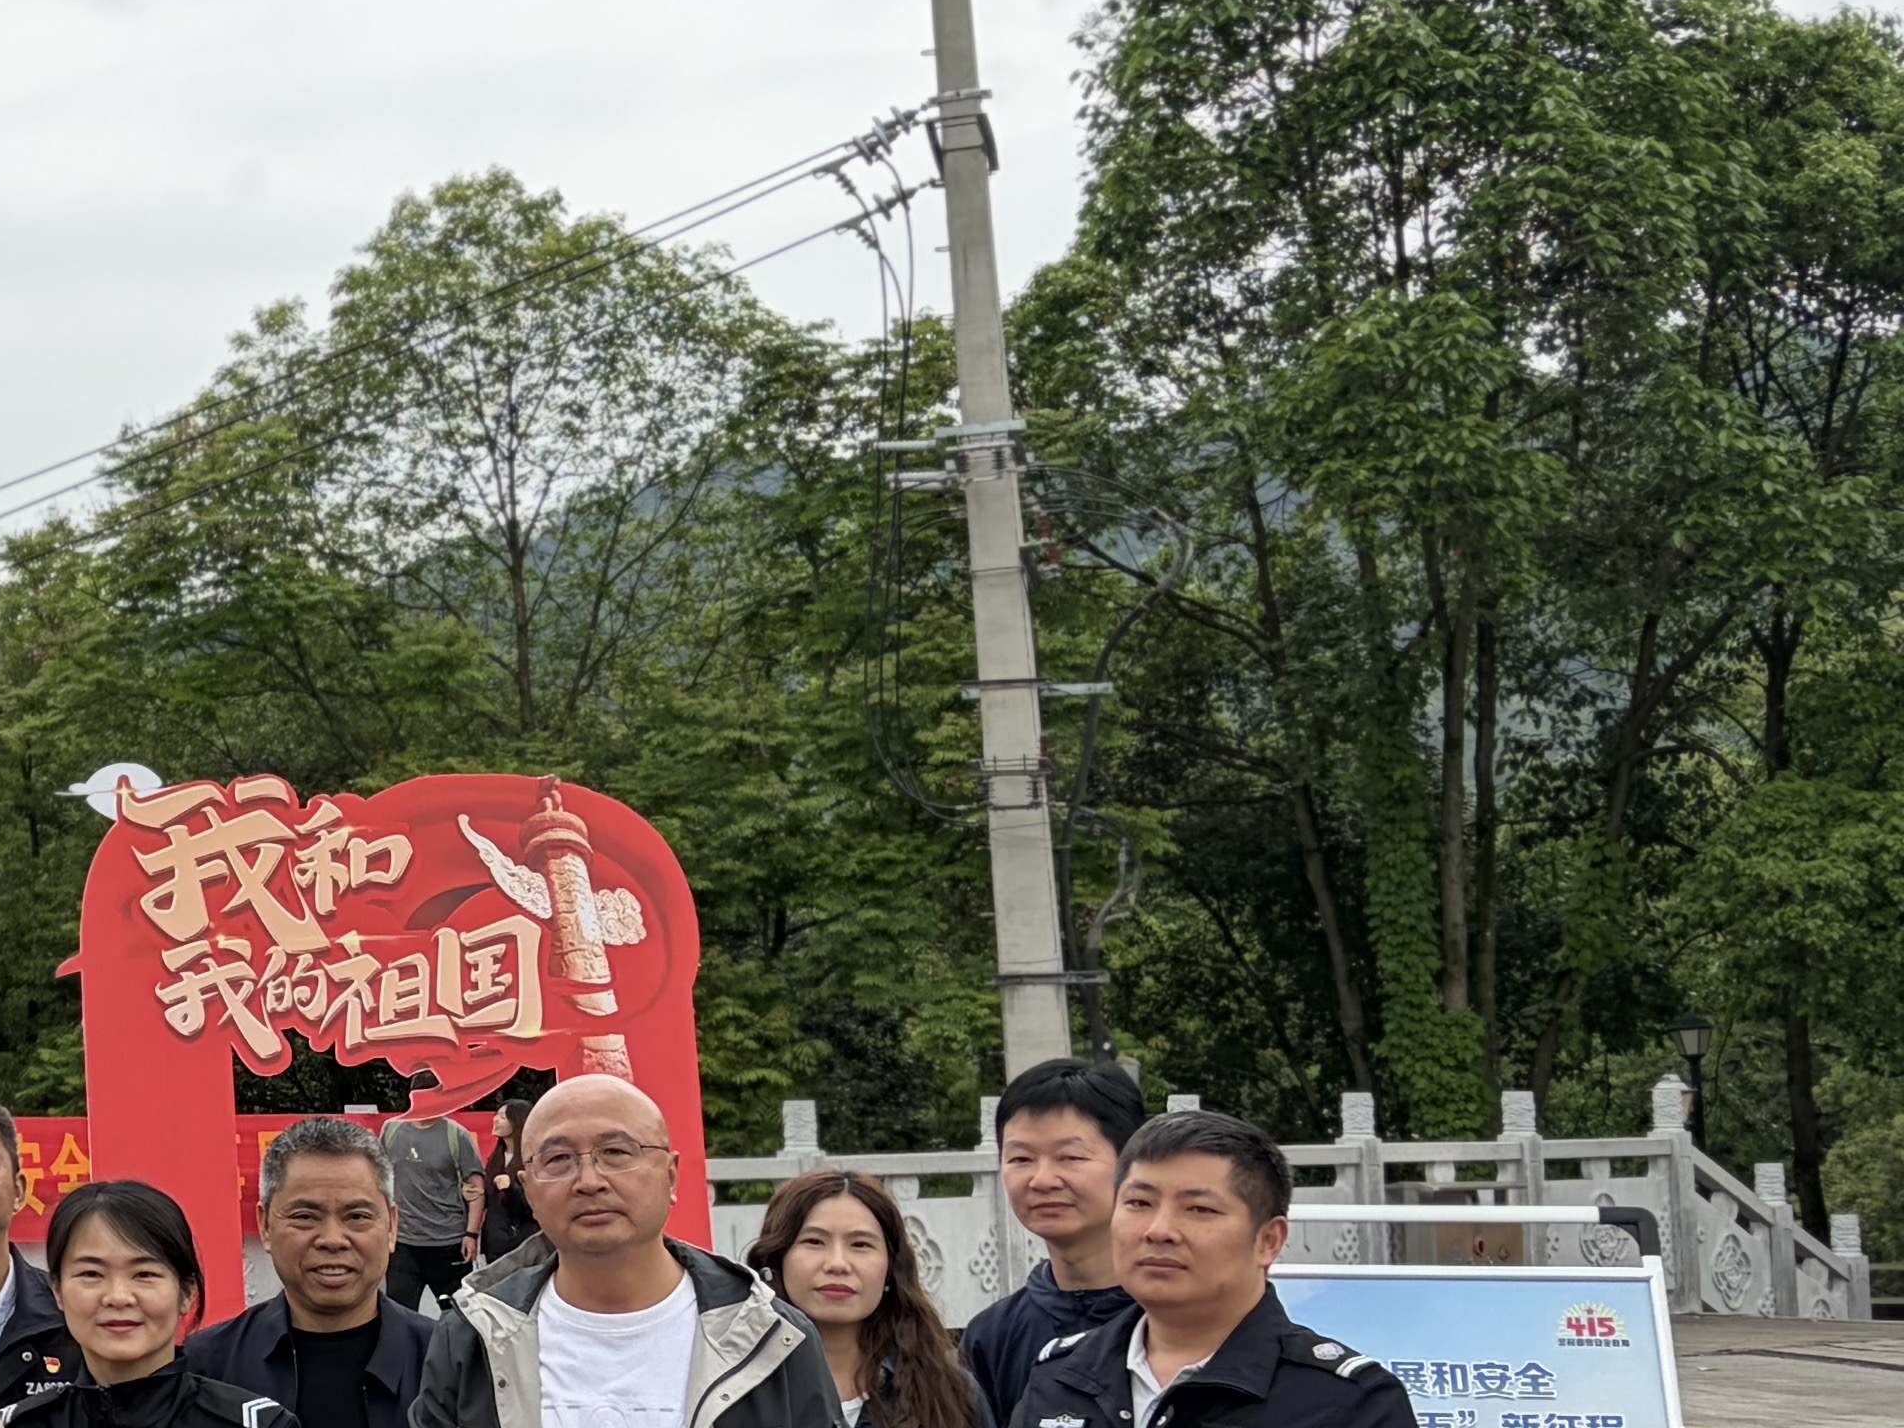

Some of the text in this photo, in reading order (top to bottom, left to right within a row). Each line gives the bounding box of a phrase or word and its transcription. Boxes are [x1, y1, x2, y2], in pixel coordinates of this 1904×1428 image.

[120, 774, 414, 953] 我和
[154, 917, 546, 1059] 我的祖国
[1566, 1316, 1617, 1338] 415
